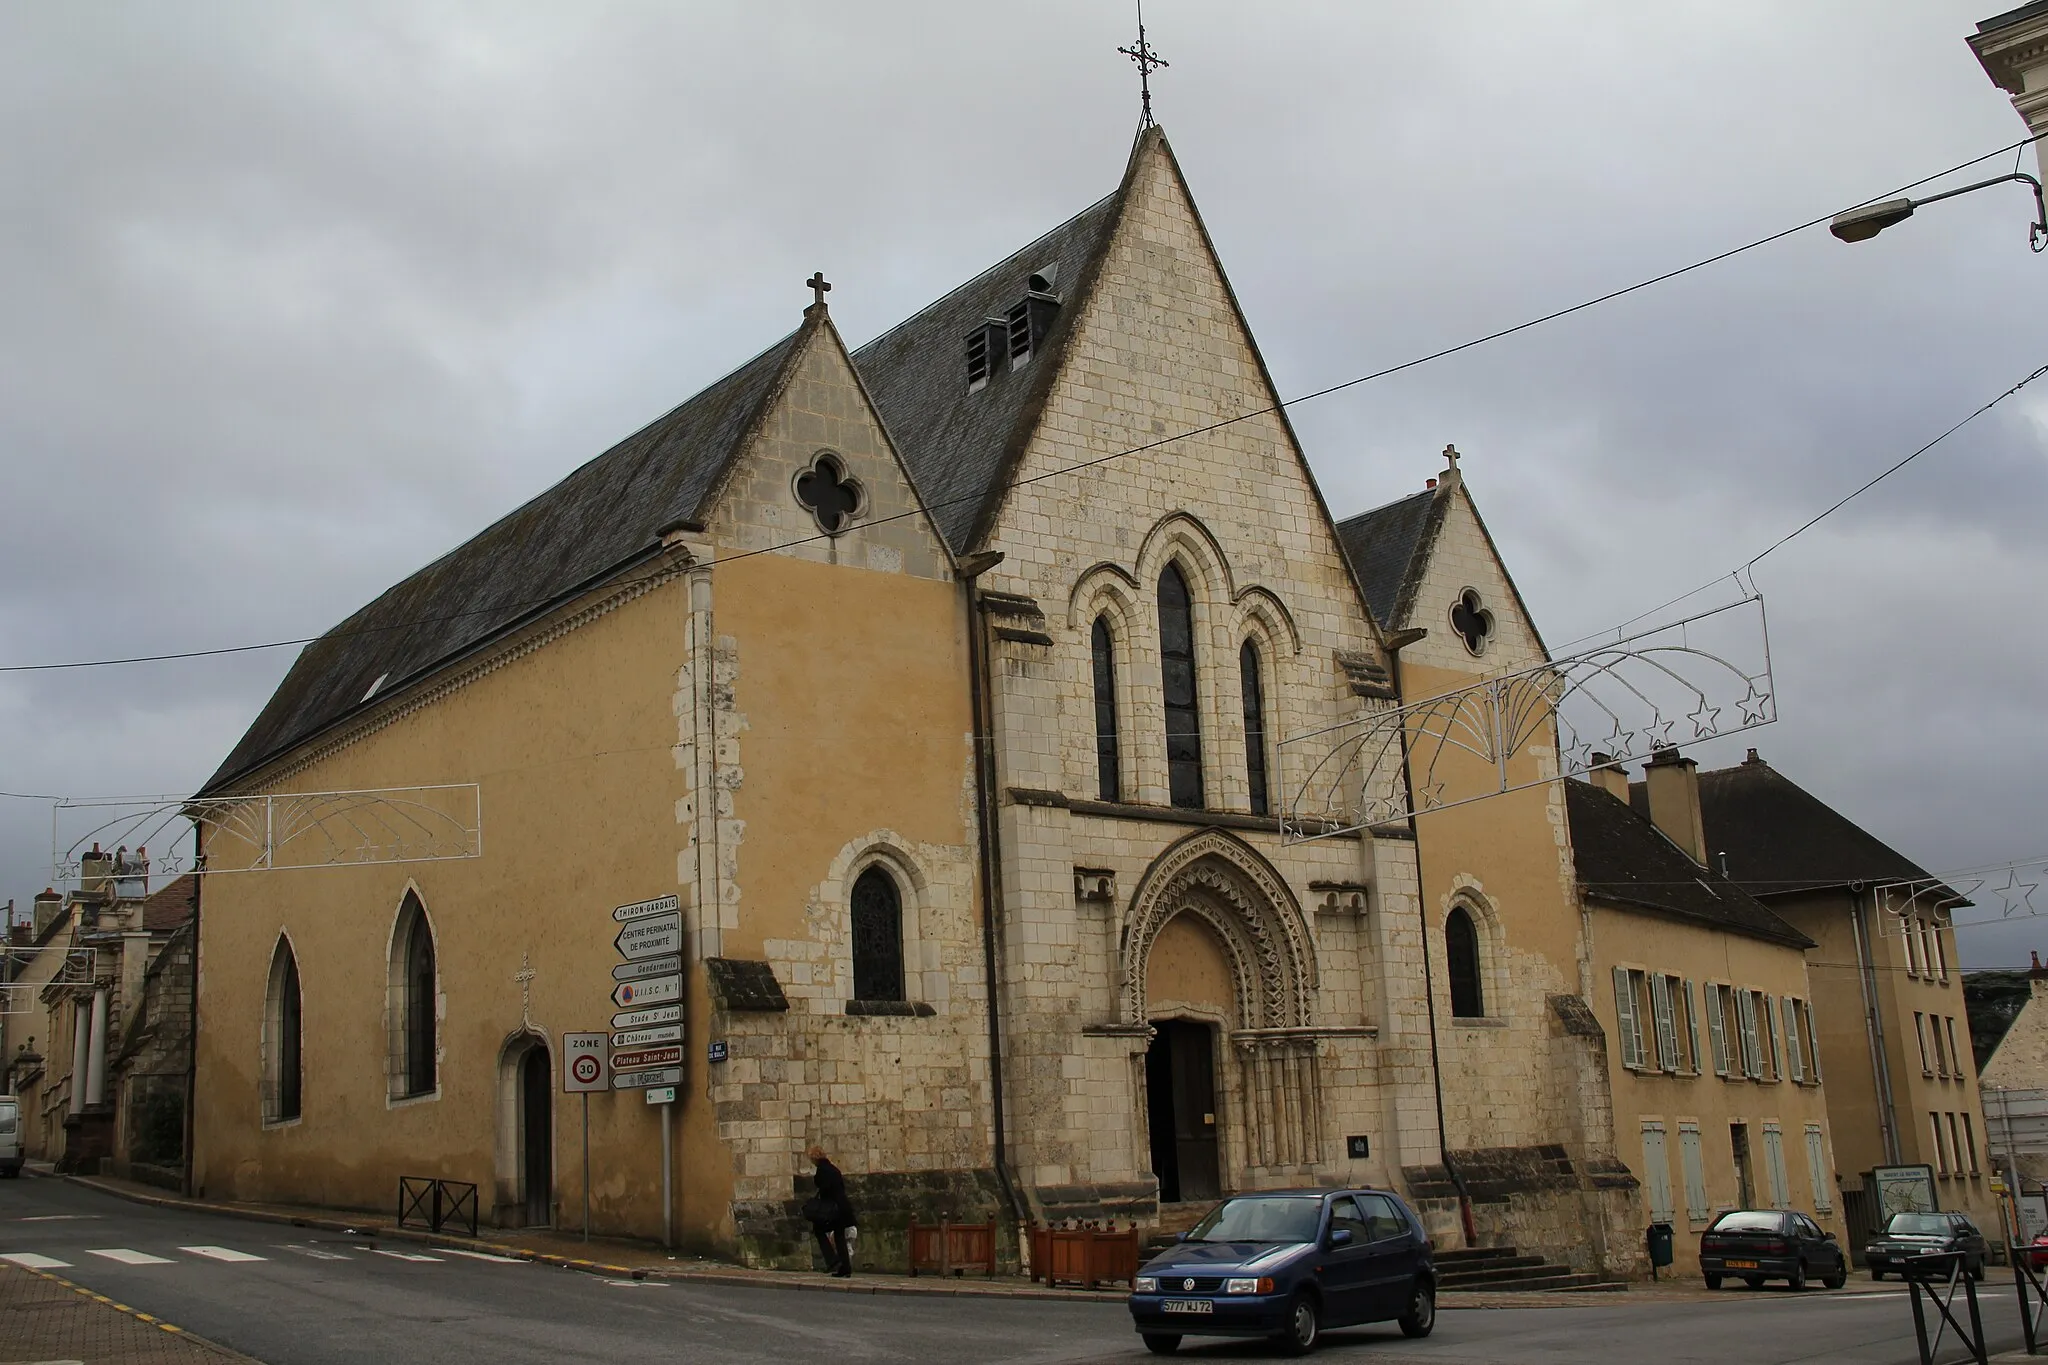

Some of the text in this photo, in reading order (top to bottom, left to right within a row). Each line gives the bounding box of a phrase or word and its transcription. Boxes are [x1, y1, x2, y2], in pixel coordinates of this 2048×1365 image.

[619, 899, 676, 918] THIRON-GARDAIS
[622, 928, 645, 940] CENTRE
[630, 935, 670, 951] DE PROXIMITÉ
[637, 961, 676, 973] Gendarmerie
[630, 1014, 649, 1023] Stade
[662, 1010, 679, 1019] Jean
[626, 1031, 675, 1043] Château musée
[573, 1039, 600, 1048] ZONE
[616, 1051, 679, 1065] Plateau Saint-Jean
[579, 1064, 594, 1074] 30
[1164, 1300, 1211, 1312] 5777 WJ 72
